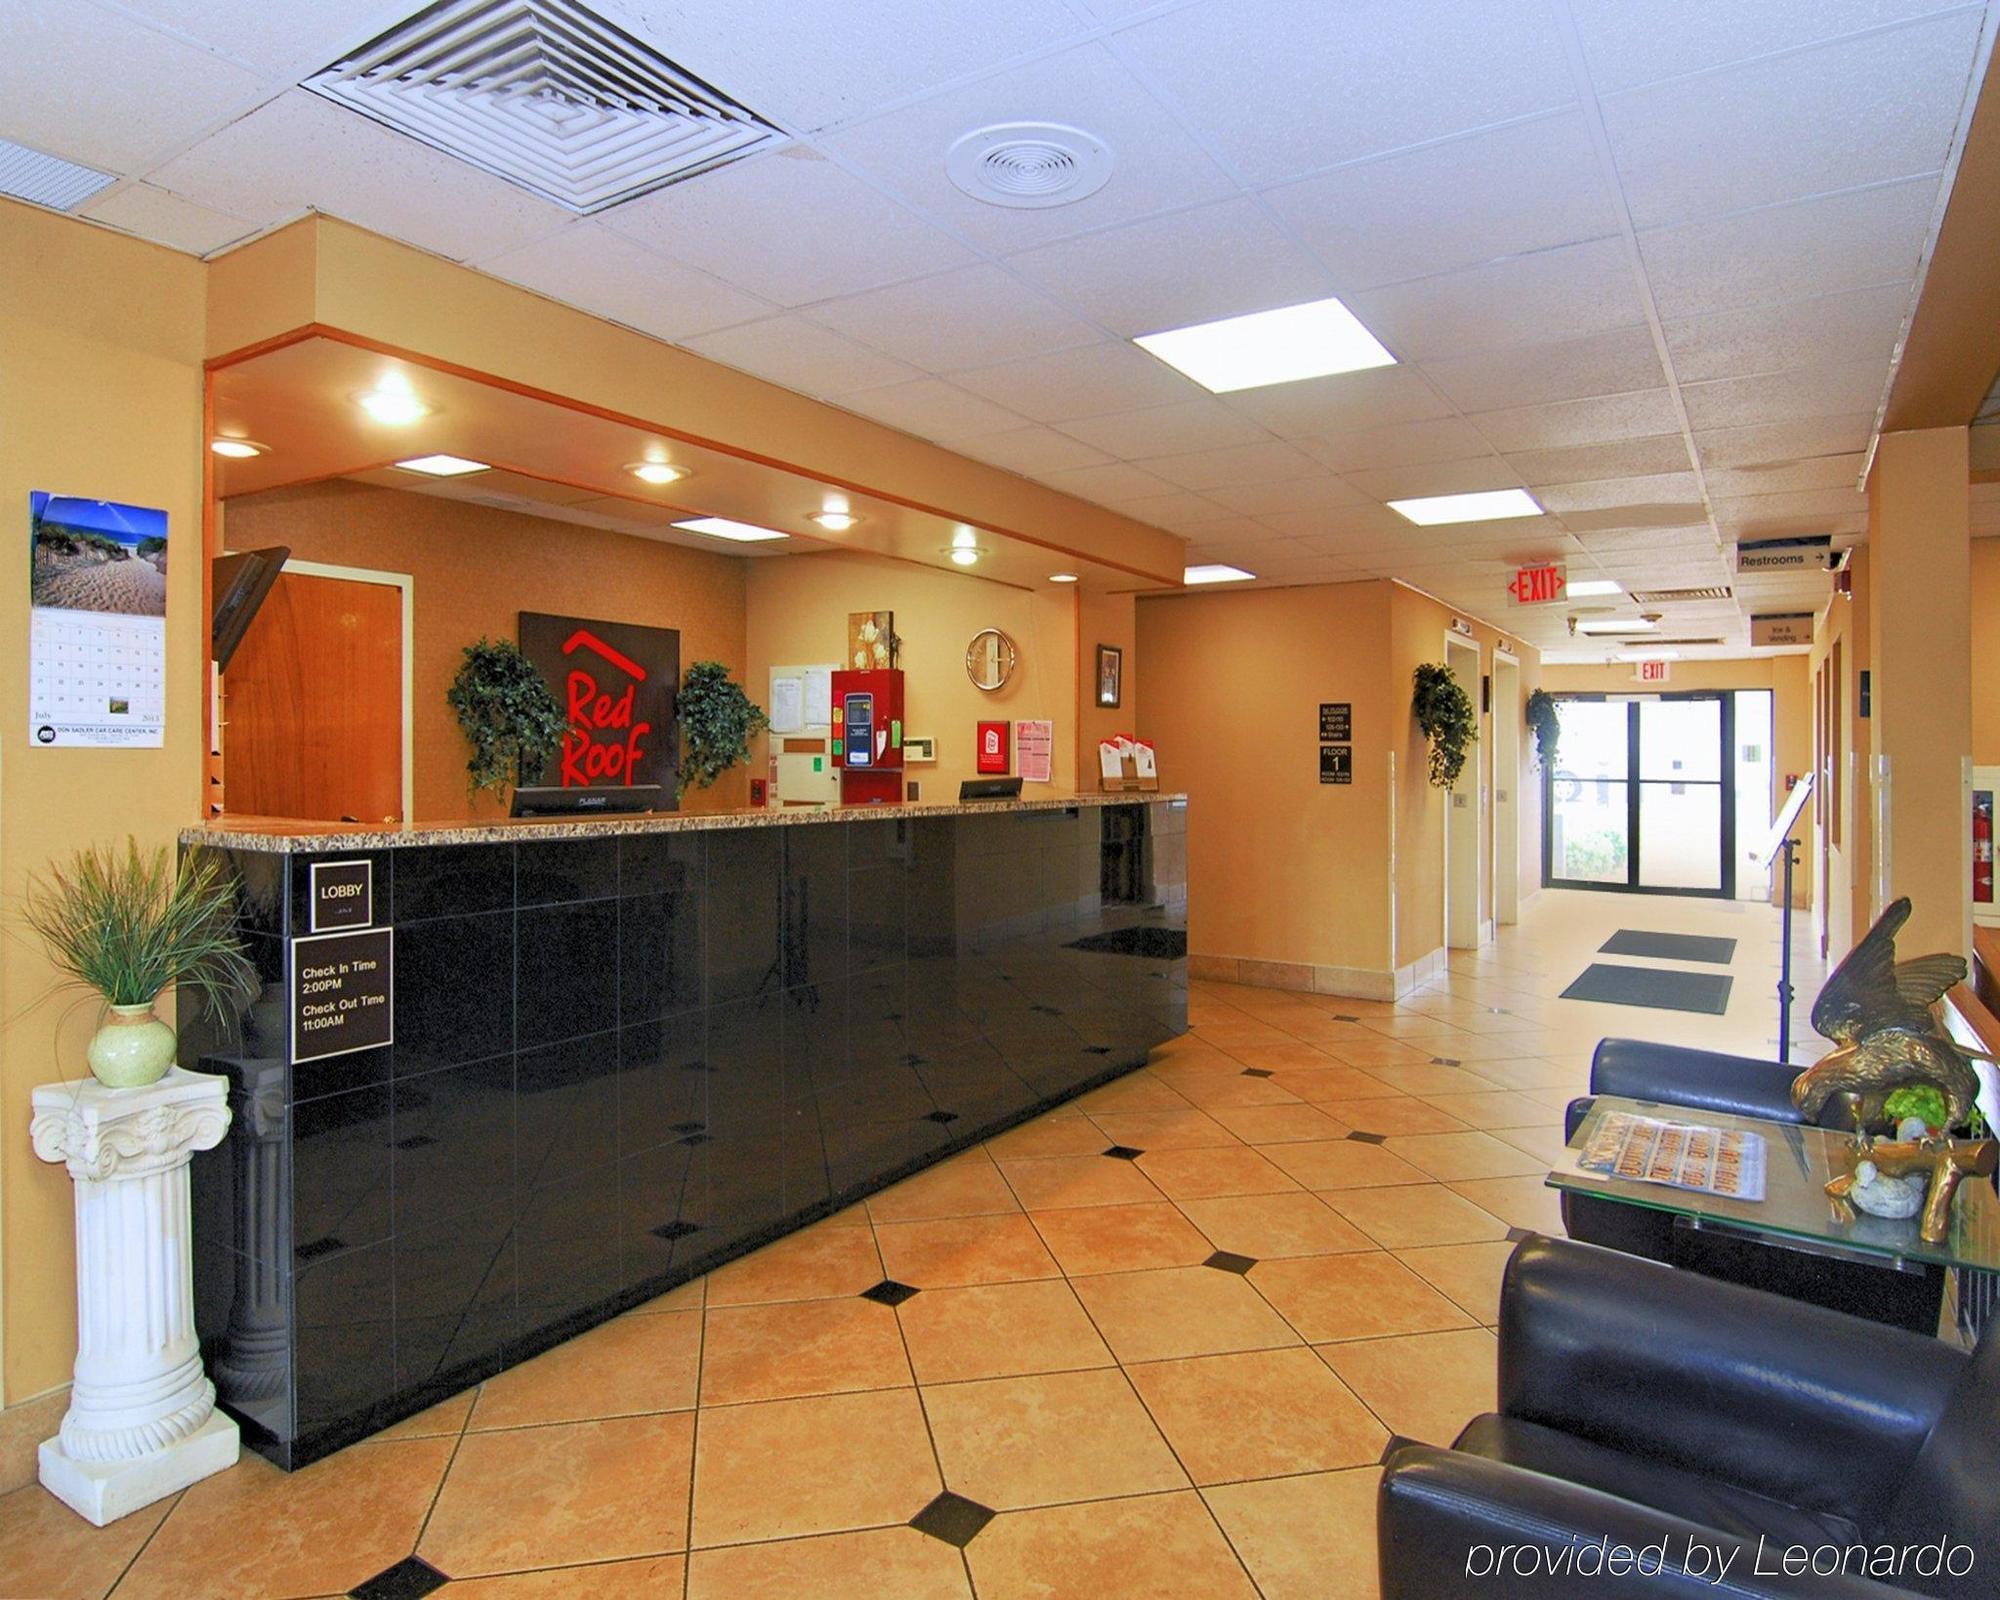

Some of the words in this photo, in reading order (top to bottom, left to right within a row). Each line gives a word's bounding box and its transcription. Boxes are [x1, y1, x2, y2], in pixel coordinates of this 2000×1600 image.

[1741, 555, 1804, 566] Restrooms
[1518, 567, 1556, 602] EXIT
[1642, 662, 1664, 679] EXIT
[568, 670, 634, 729] Red
[561, 722, 650, 789] Roof
[1323, 748, 1347, 756] FLOOR
[1332, 756, 1339, 771] 1
[321, 883, 363, 899] LOBBY
[302, 966, 336, 979] Check
[339, 963, 349, 974] In
[352, 960, 377, 972] Time
[302, 978, 342, 994] 2:00PM
[302, 1003, 336, 1016] Check
[339, 999, 358, 1011] Out
[361, 995, 385, 1007] Time
[302, 1015, 344, 1031] 11:00AM
